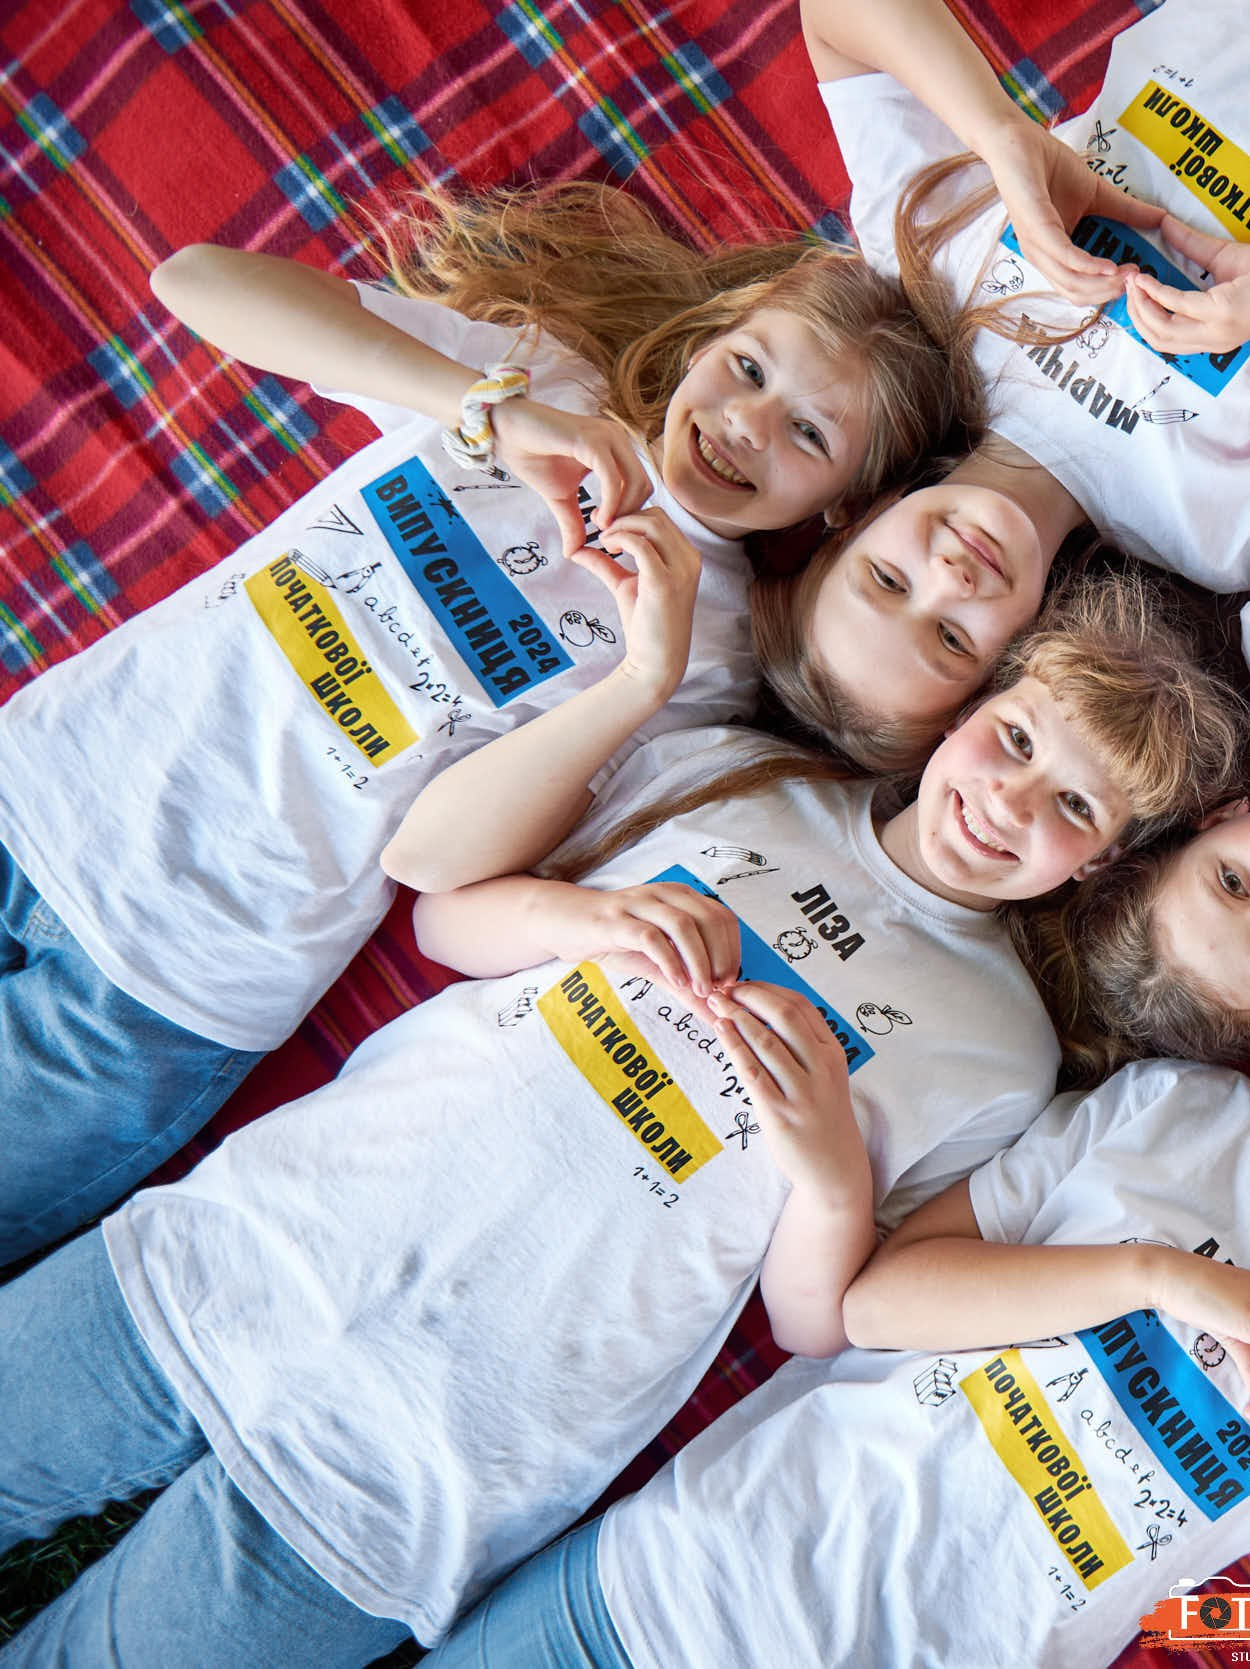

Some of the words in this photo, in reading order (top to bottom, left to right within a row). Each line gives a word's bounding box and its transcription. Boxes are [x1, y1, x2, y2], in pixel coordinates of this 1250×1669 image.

[1143, 87, 1223, 156] ШКОЛИ
[269, 556, 372, 685] ПОЧАТКОВОЇ
[375, 474, 532, 696] ВИПУСКНИЦЯ
[508, 613, 561, 674] 2024
[310, 671, 391, 759] ШКОЛИ
[791, 883, 865, 962] ЛІЗА
[560, 970, 674, 1100] ПОЧАТКОВОЇ
[611, 1086, 694, 1175] ШКОЛИ
[983, 1357, 1093, 1501] ПОЧАТКОВОЇ
[1033, 1486, 1105, 1580] ШКОЛИ
